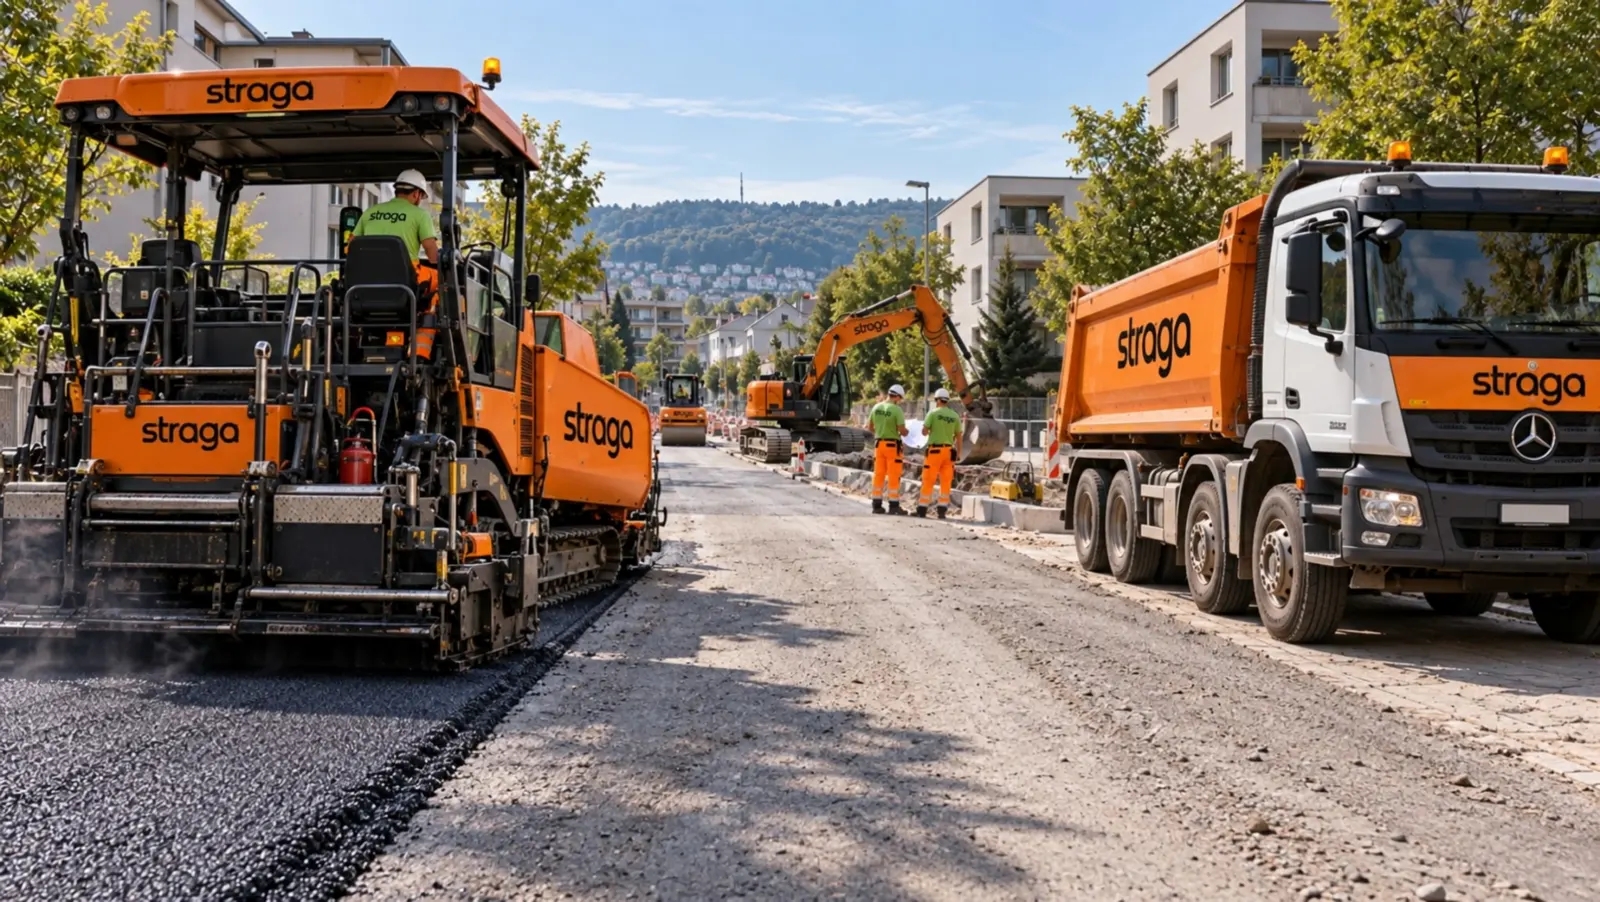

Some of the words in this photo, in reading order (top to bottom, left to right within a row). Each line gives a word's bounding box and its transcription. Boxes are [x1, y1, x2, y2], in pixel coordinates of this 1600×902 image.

[207, 77, 314, 109] straga
[1117, 312, 1191, 379] straga
[1472, 365, 1586, 406] straga
[142, 416, 239, 452] straga
[563, 401, 633, 459] straga
